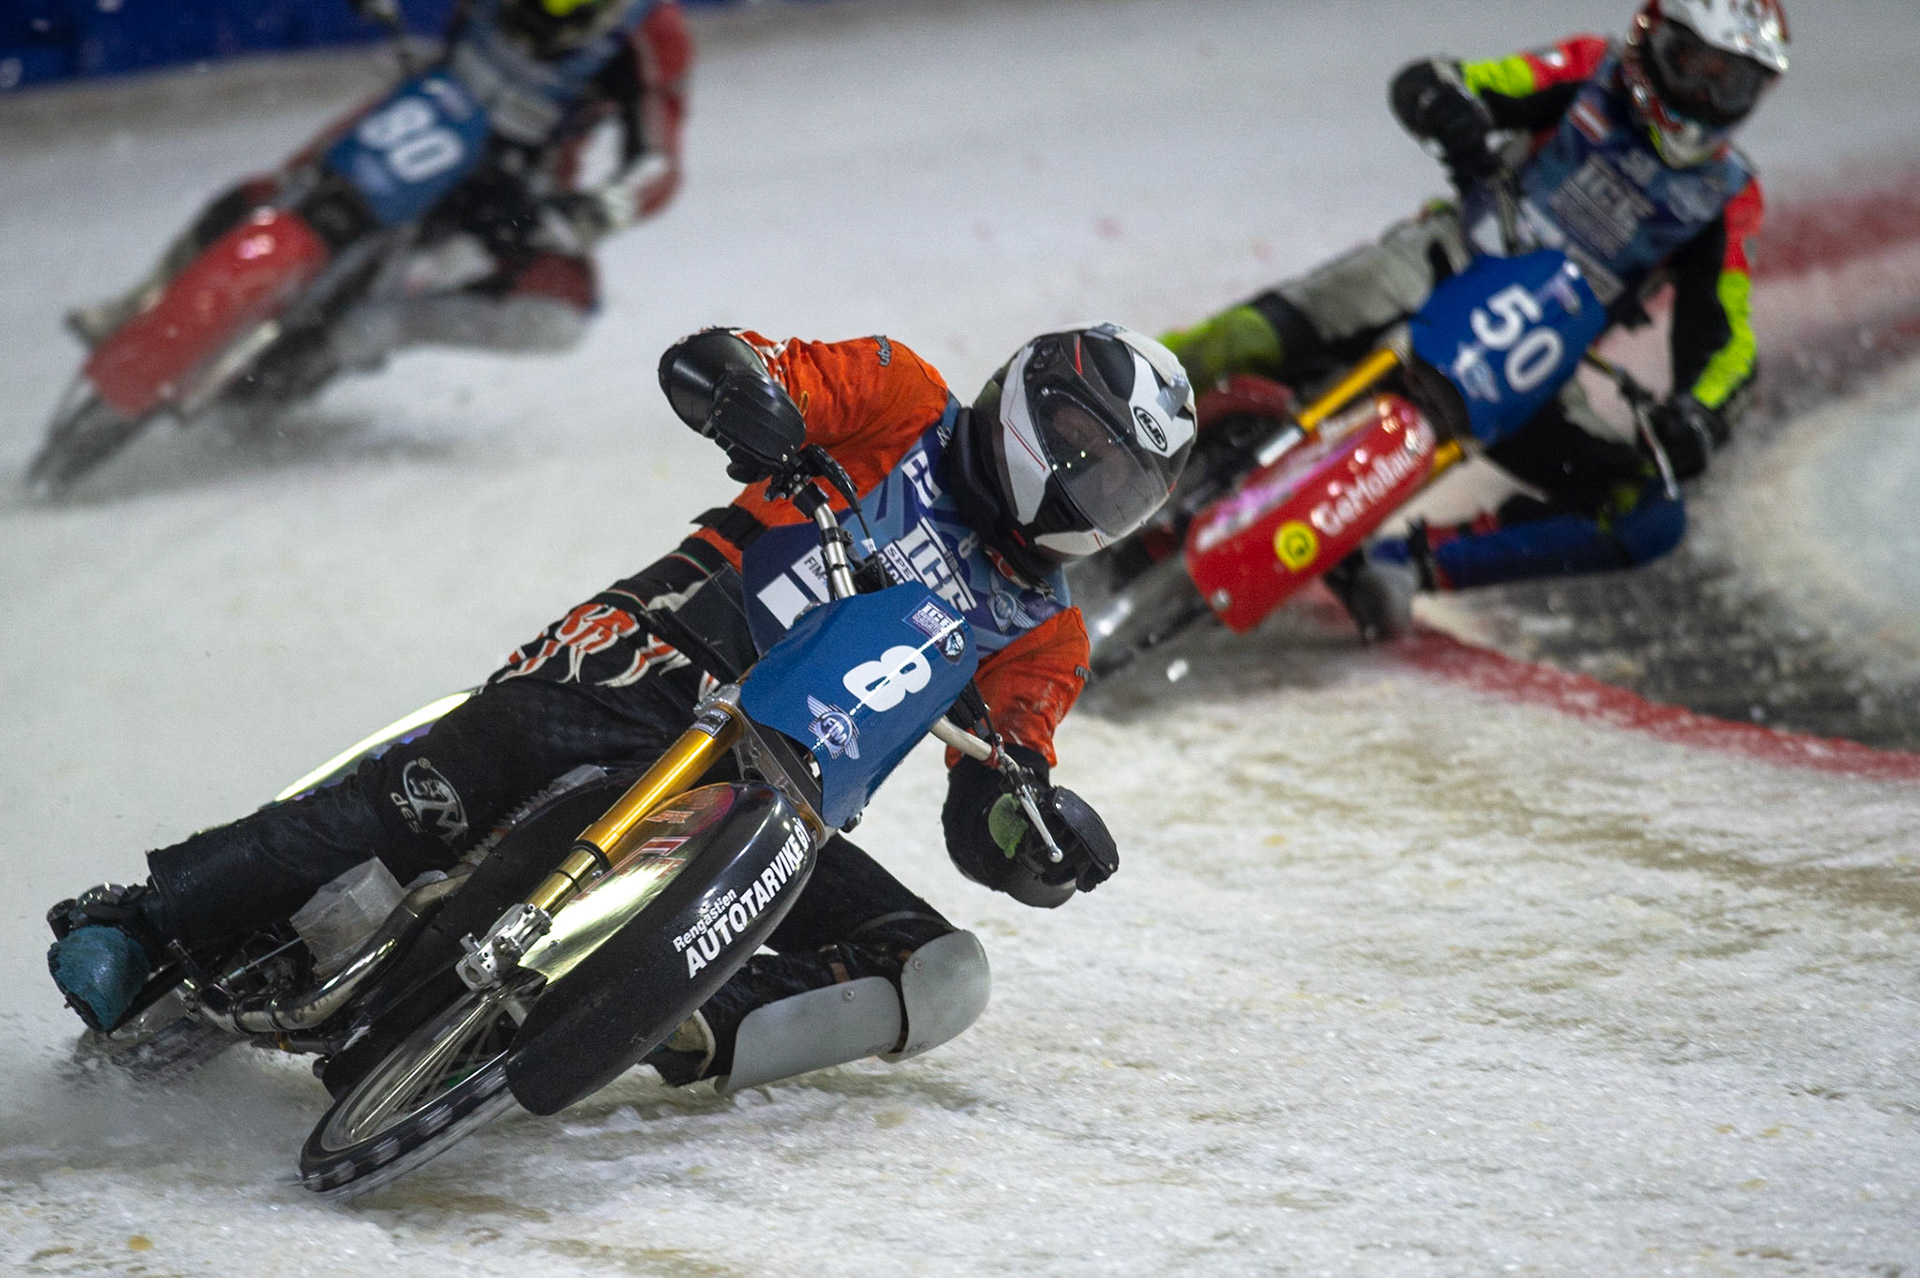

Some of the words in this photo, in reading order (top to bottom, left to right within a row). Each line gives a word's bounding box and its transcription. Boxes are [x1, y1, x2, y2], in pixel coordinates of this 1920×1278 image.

[1470, 283, 1563, 392] 50
[1138, 413, 1165, 445] HJC
[894, 520, 973, 612] ICE
[843, 645, 931, 712] 8
[685, 833, 805, 979] AUTOTARVIKE
